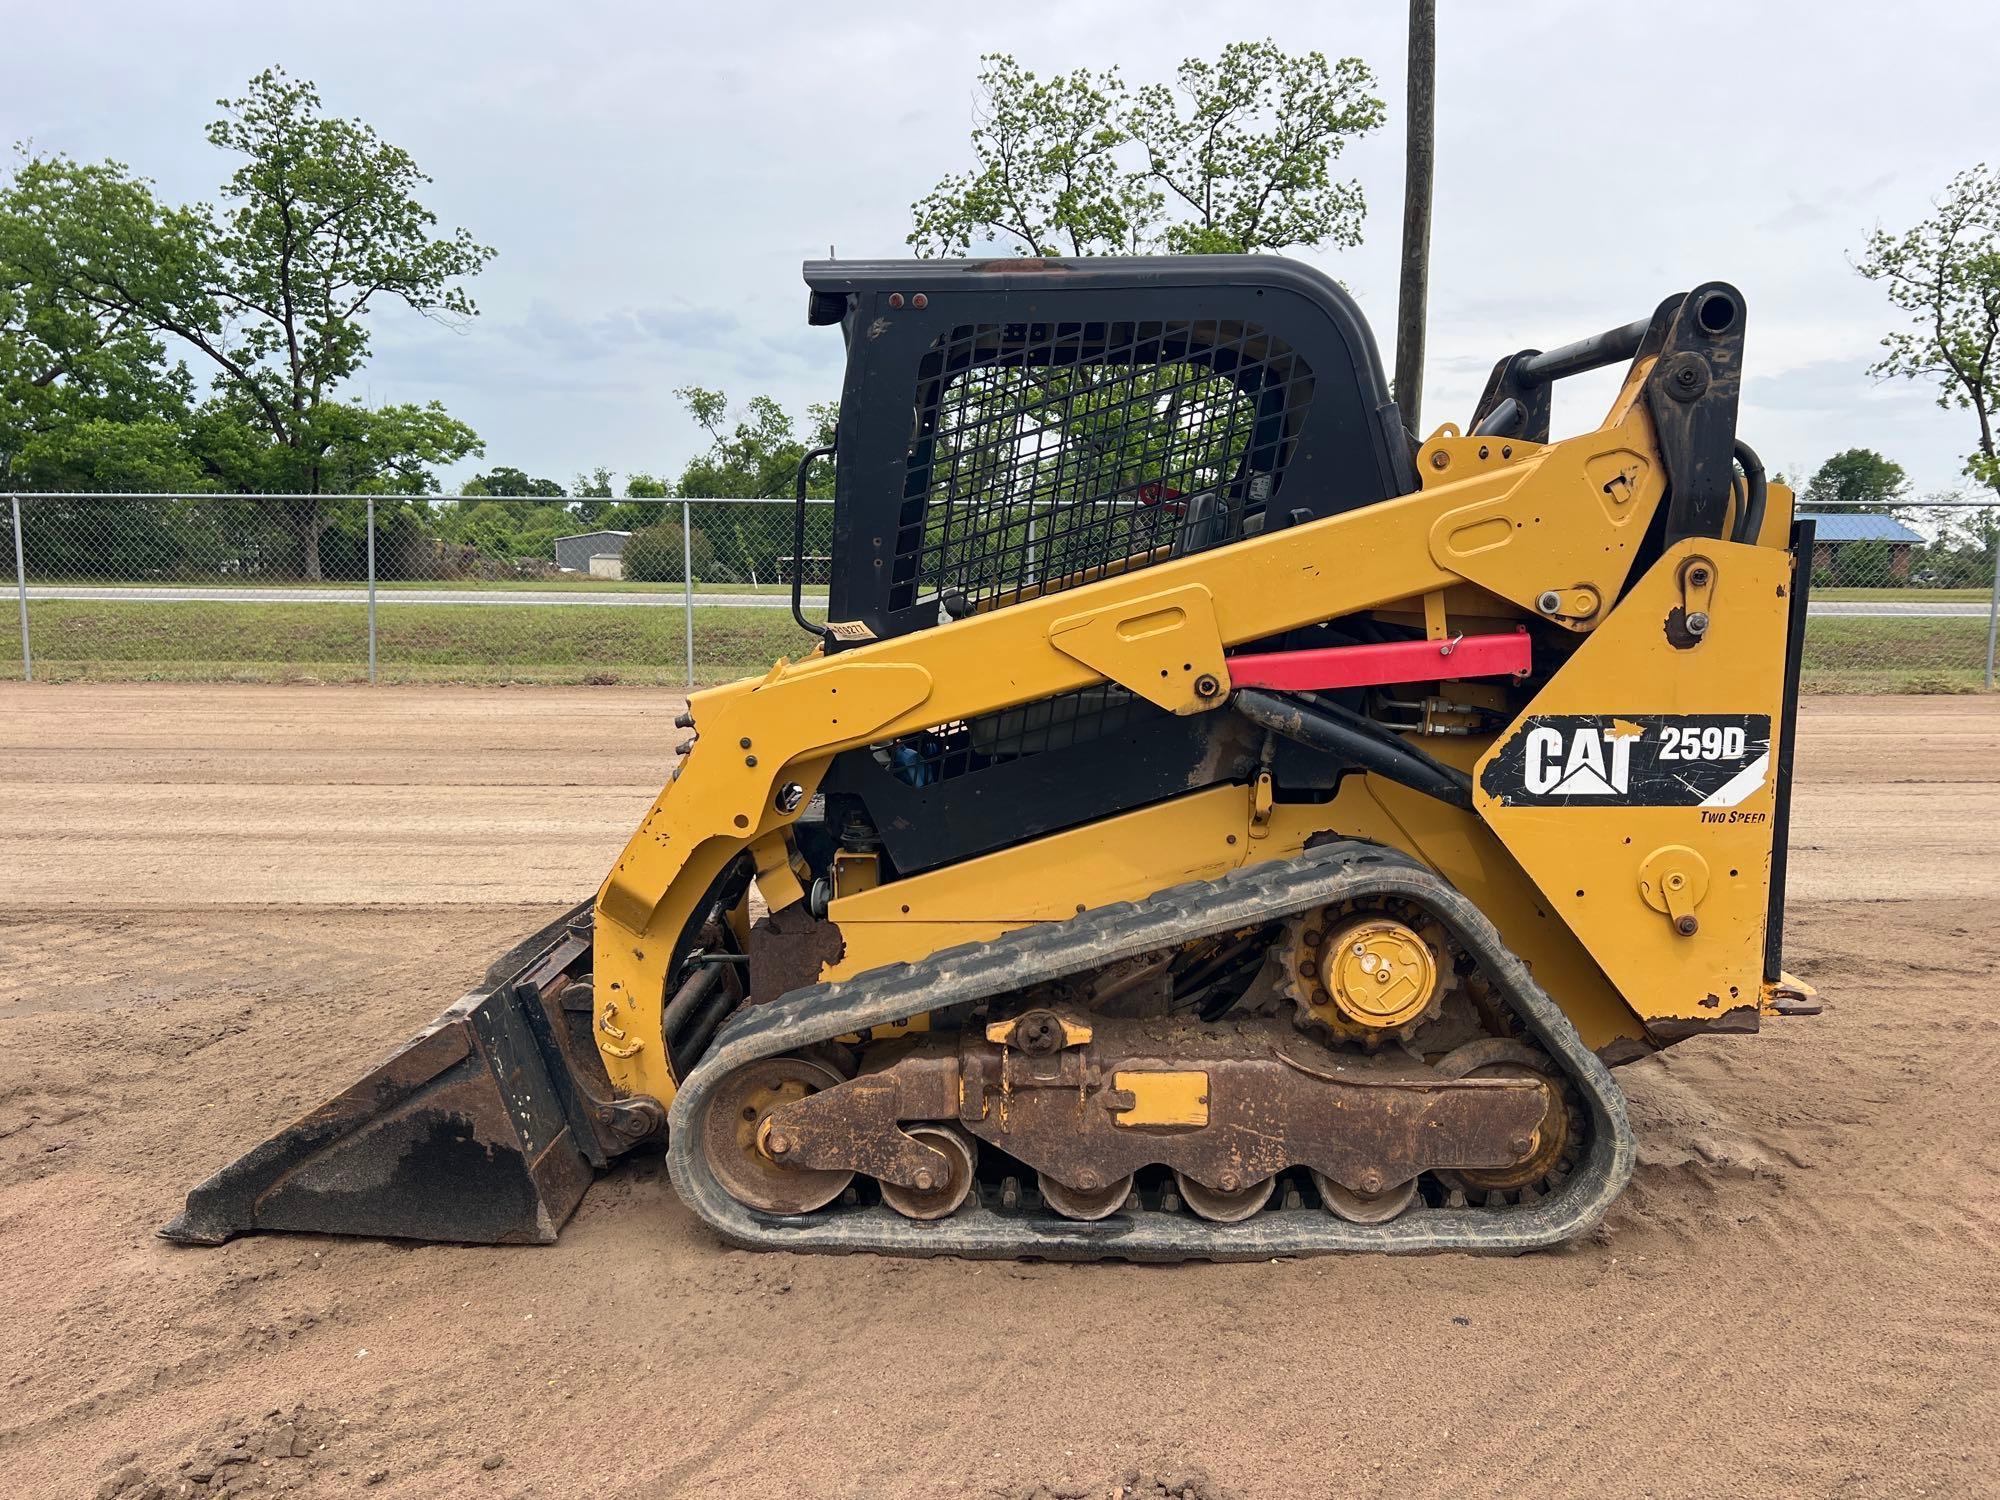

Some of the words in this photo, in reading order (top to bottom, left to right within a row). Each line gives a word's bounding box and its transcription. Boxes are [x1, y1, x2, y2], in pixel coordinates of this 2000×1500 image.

[1525, 727, 1640, 795] CAT
[1659, 726, 1746, 761] 259D
[1701, 810, 1726, 824] TWO
